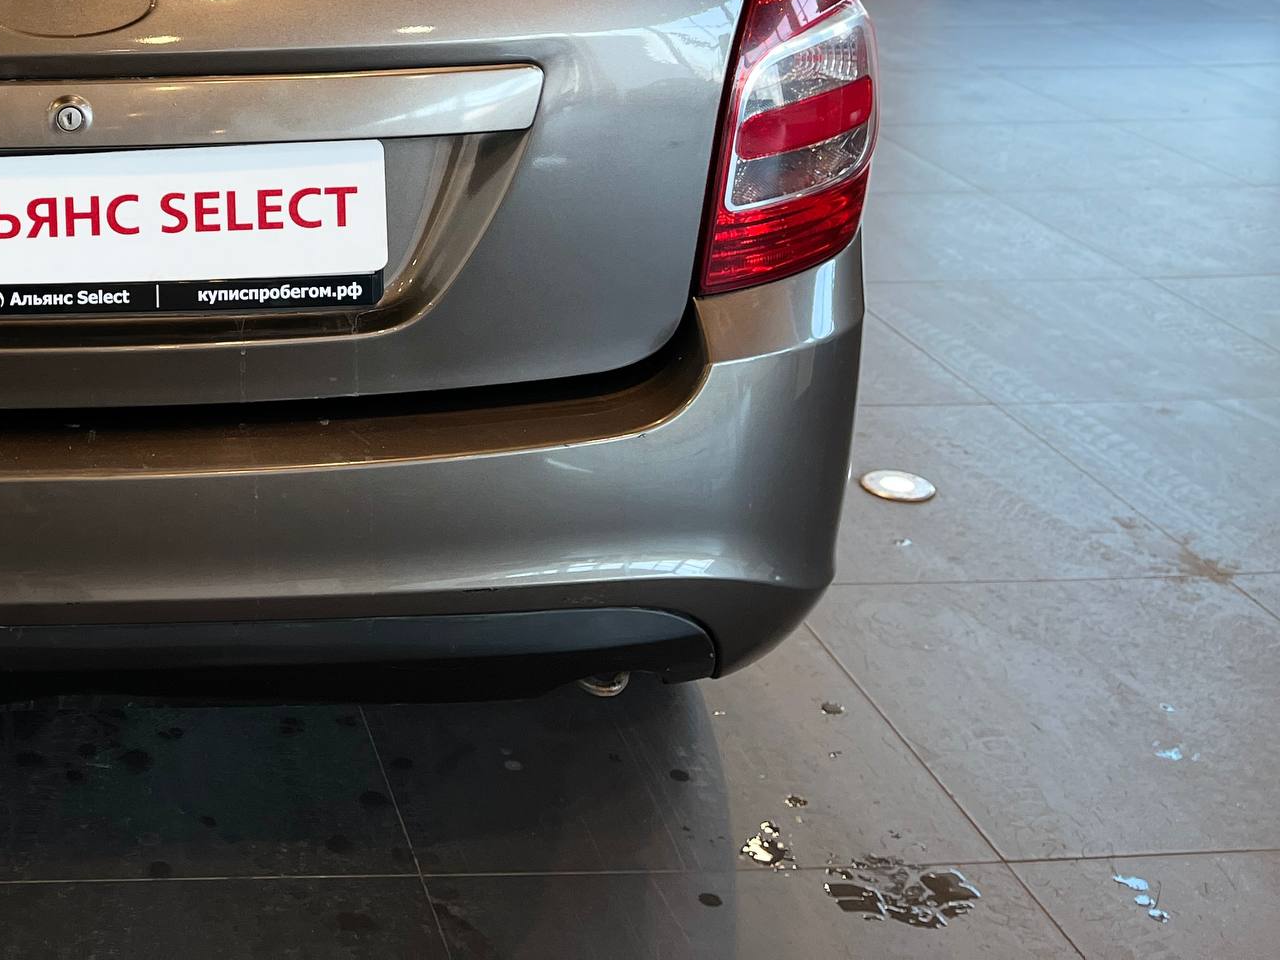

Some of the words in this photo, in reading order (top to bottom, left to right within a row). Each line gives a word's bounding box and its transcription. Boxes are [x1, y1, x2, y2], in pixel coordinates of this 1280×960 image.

[159, 186, 358, 234] SELECT
[9, 290, 74, 306] Альянс
[77, 289, 131, 305] Select
[197, 281, 363, 305] куписпробегом.рф
